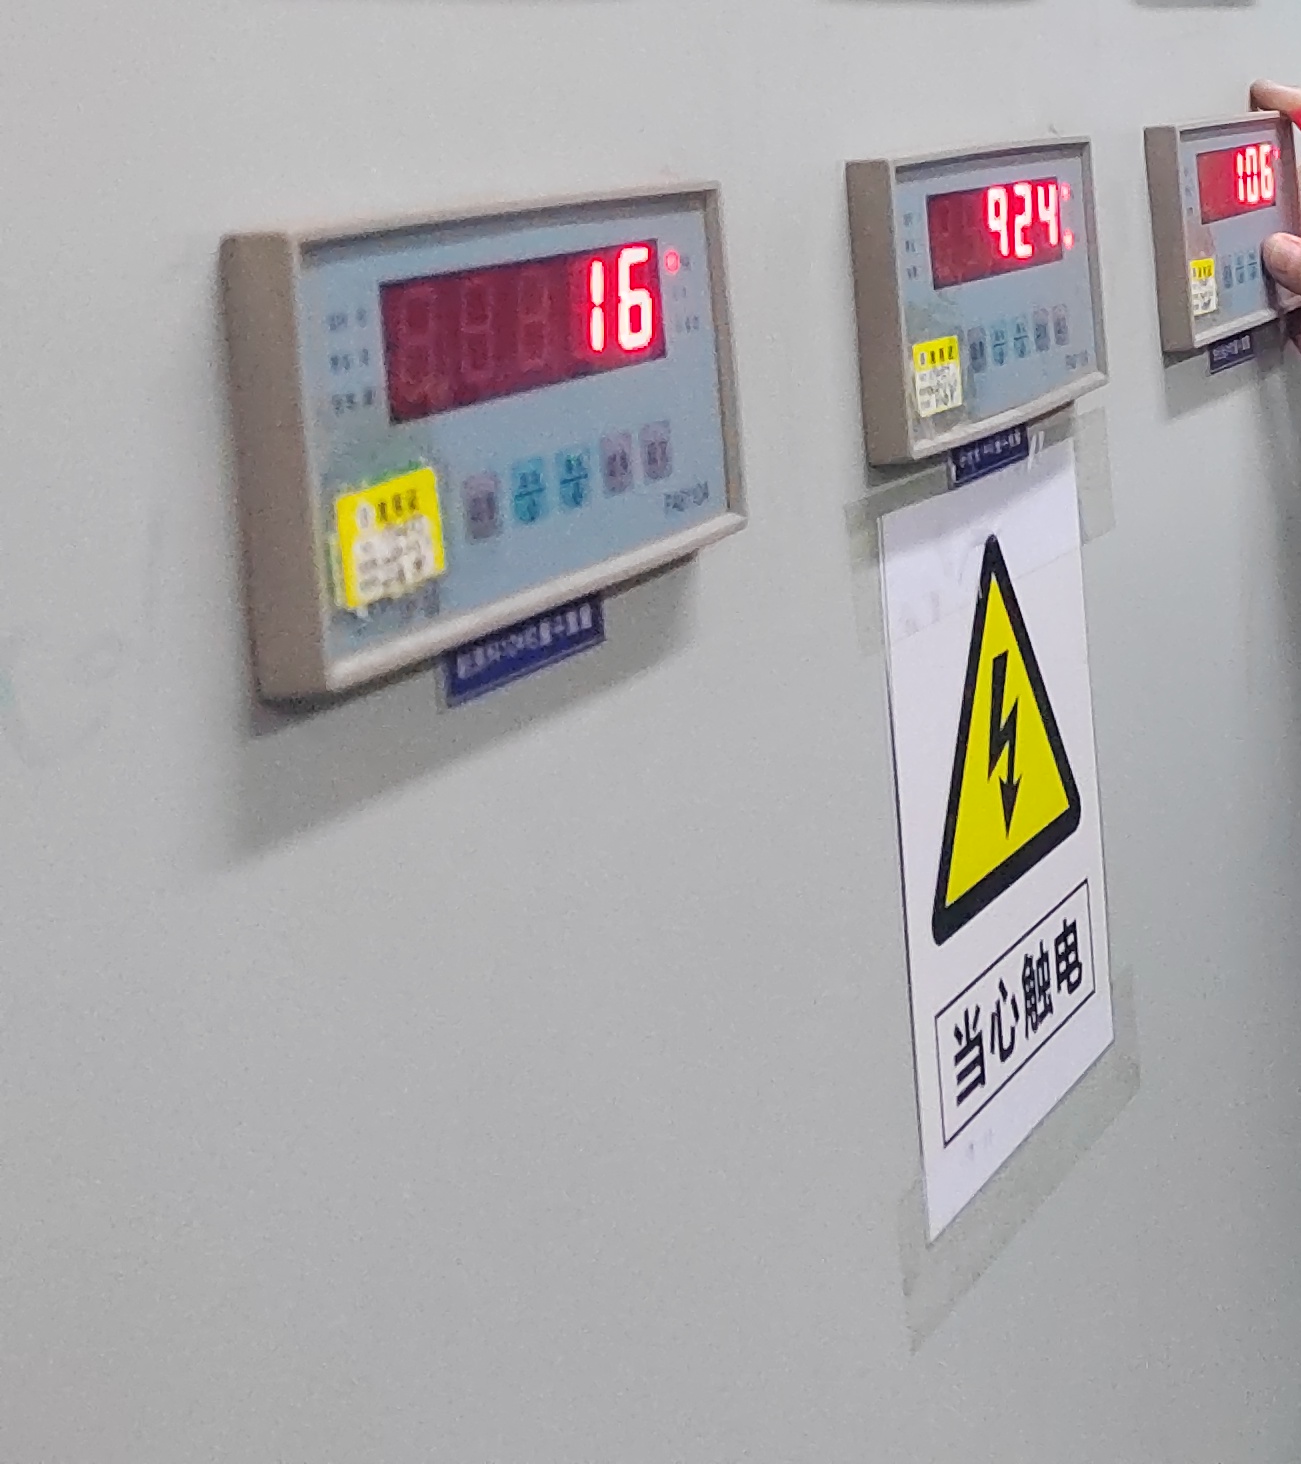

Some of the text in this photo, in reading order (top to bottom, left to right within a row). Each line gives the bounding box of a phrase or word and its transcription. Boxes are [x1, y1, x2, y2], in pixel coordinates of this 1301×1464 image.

[1237, 145, 1274, 203] 106
[987, 182, 1060, 259] 924
[589, 246, 652, 353] 16
[953, 918, 1083, 1107] 当心触电
